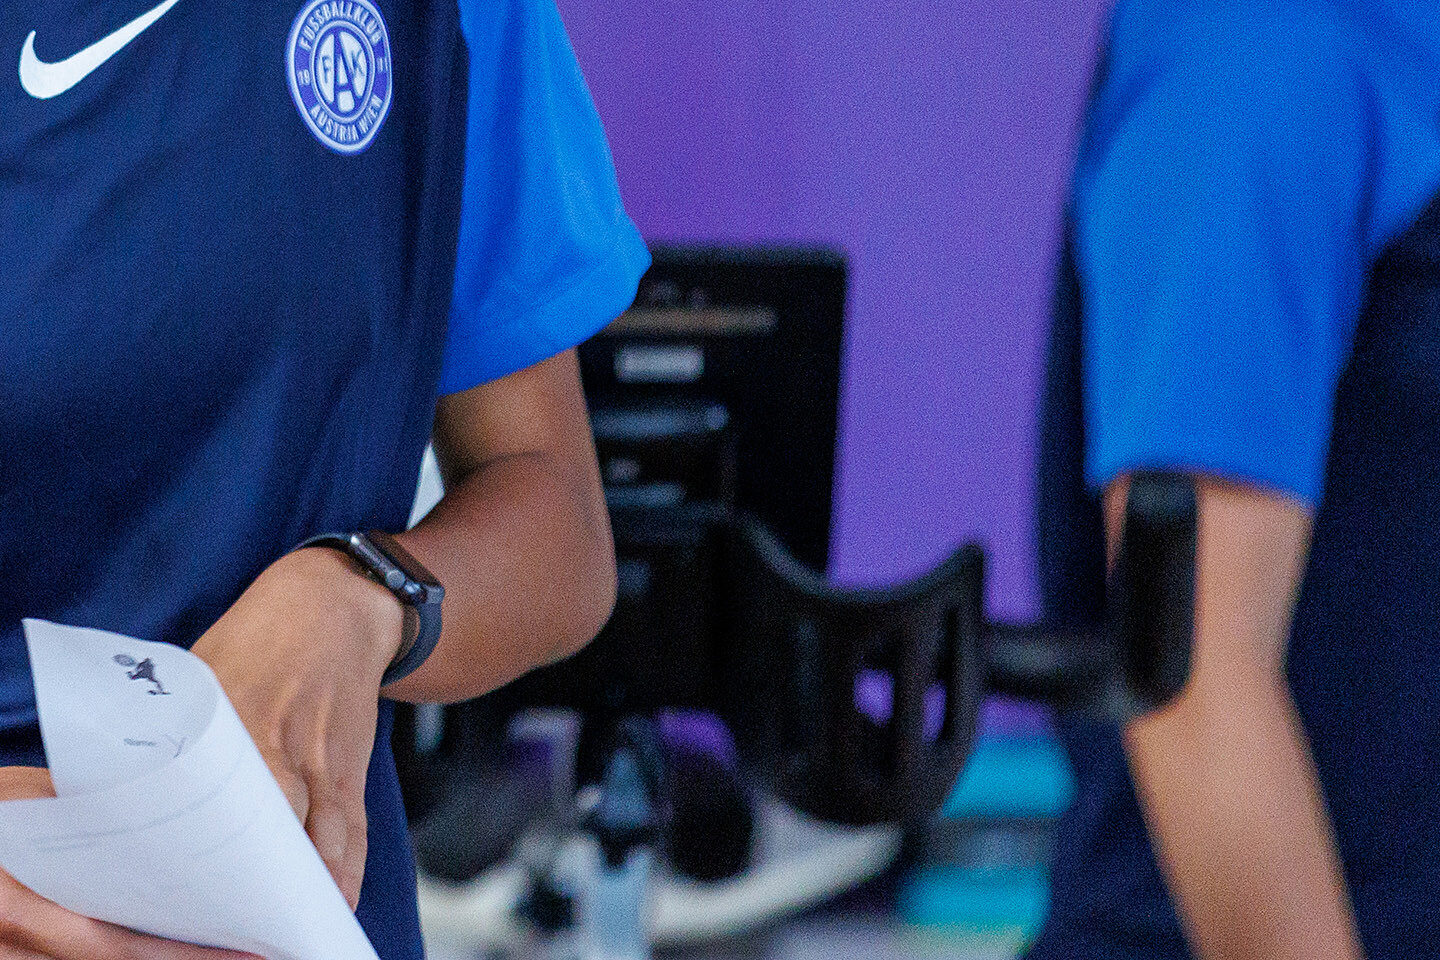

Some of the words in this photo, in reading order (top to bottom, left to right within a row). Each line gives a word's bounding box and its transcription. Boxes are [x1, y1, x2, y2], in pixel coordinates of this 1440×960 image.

[297, 69, 310, 86] 19
[310, 103, 360, 141] AUSTRIA
[358, 94, 383, 133] WIEN
